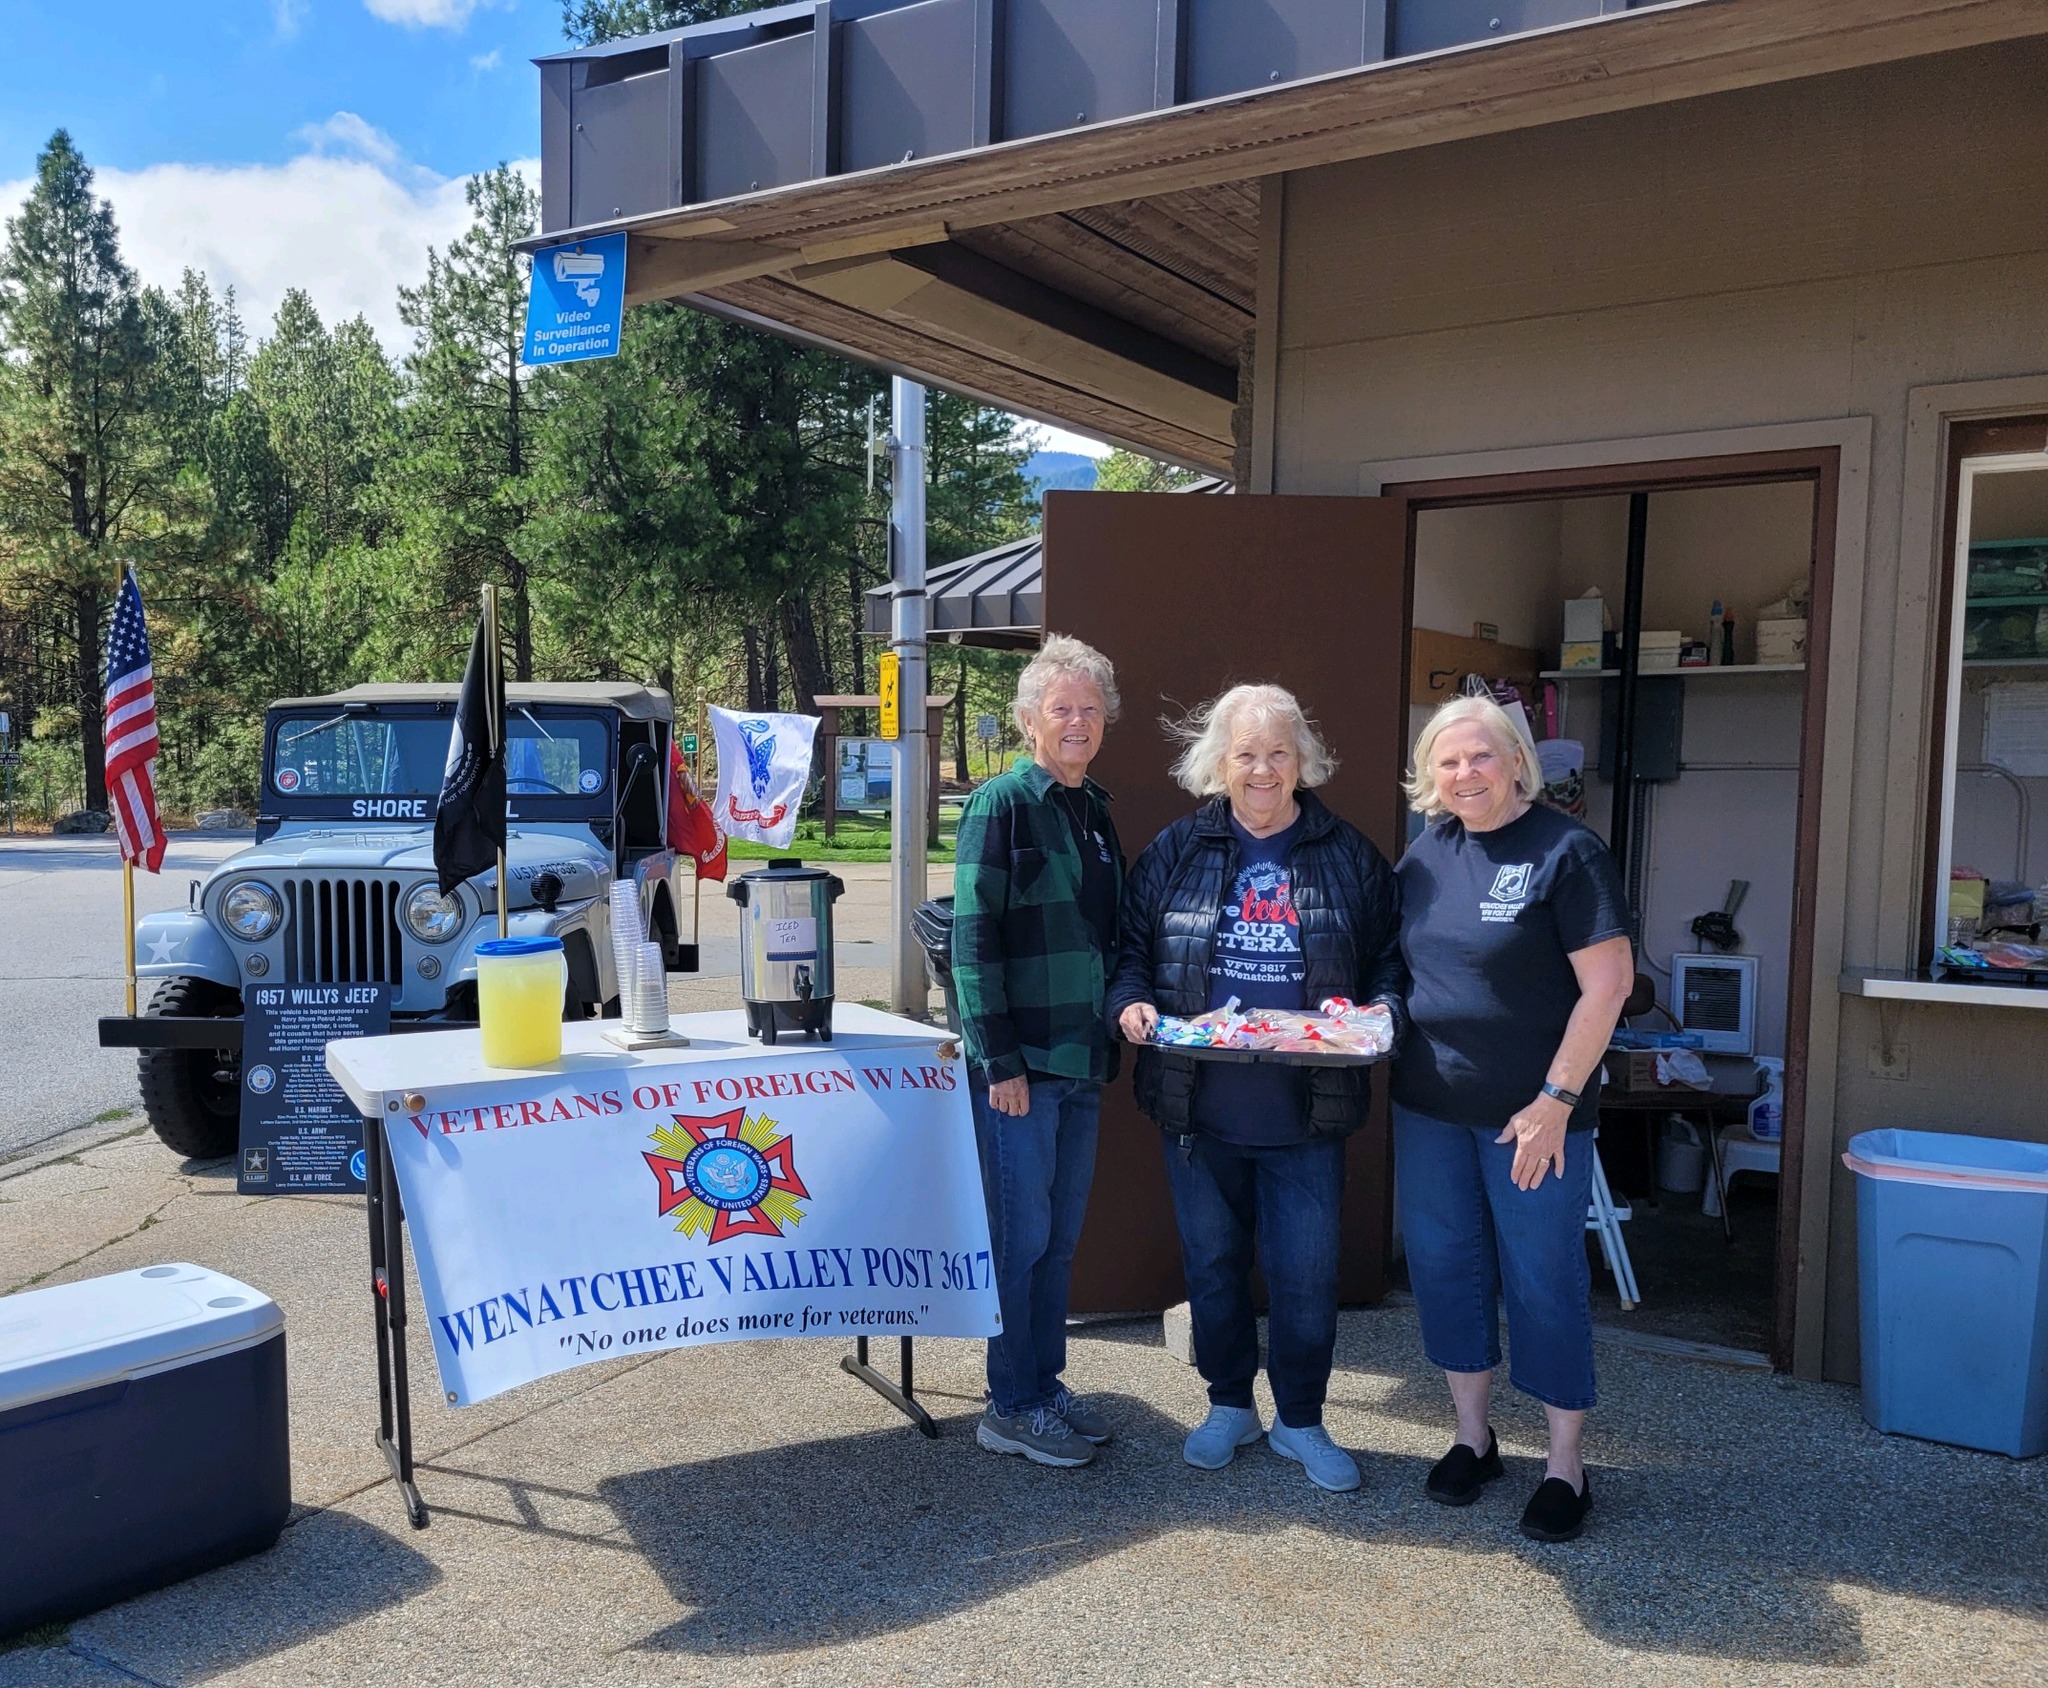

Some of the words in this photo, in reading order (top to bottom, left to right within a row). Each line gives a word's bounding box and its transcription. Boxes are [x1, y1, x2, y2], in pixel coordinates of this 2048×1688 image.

[556, 311, 591, 324] Video
[534, 323, 611, 342] Surveillance
[533, 345, 545, 356] In
[548, 338, 610, 356] Operation
[445, 792, 458, 804] NOT
[352, 800, 426, 818] SHORE
[1222, 905, 1240, 917] e
[775, 920, 800, 932] ICED
[1233, 920, 1286, 938] OUR
[779, 933, 797, 944] TEA
[1217, 932, 1300, 952] TERA
[1209, 966, 1222, 976] st
[1223, 968, 1290, 982] Wenatchee,
[1291, 972, 1305, 980] W
[1225, 960, 1258, 972] VFW
[1260, 964, 1286, 972] 3617
[256, 990, 285, 1006] 1957
[291, 988, 339, 1004] WILLYS
[344, 988, 378, 1004] JEEP
[408, 1089, 623, 1140] VETERANS
[632, 1083, 682, 1110] OF
[690, 1069, 856, 1104] FOREIGN
[862, 1065, 957, 1092] WARS
[686, 1147, 704, 1184] VETERANS
[704, 1140, 714, 1150] OF
[716, 1140, 752, 1154] FOREIGN
[752, 1153, 768, 1175] WARS
[693, 1186, 704, 1198] OF
[704, 1194, 719, 1207] THE
[722, 1199, 752, 1210] UNITED
[752, 1178, 769, 1202] STATES
[438, 1260, 704, 1356] WENATCHEE
[707, 1247, 853, 1295] VALLEY
[860, 1247, 936, 1290] POST
[940, 1250, 990, 1291] 3617
[560, 1329, 613, 1356] "No
[622, 1324, 668, 1346] one
[676, 1316, 730, 1338] does
[738, 1310, 794, 1331] more
[798, 1305, 832, 1333] for
[838, 1304, 930, 1326] veterans."
